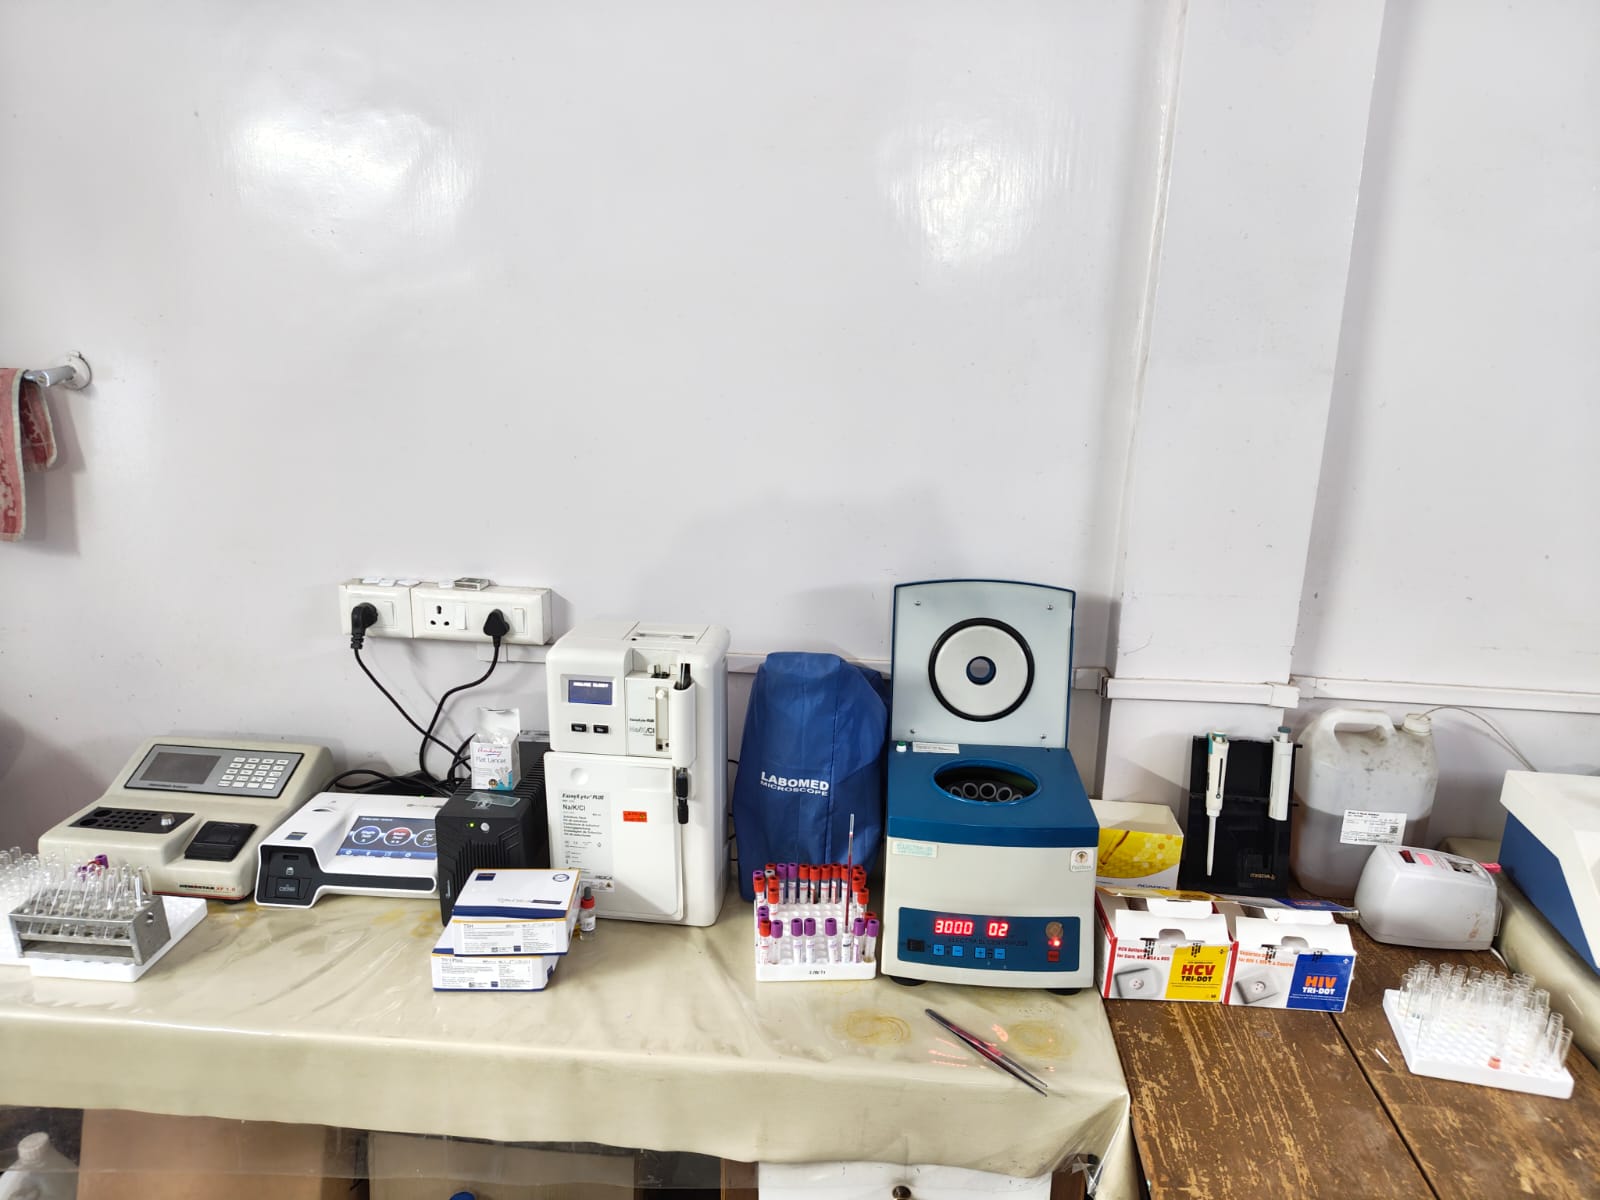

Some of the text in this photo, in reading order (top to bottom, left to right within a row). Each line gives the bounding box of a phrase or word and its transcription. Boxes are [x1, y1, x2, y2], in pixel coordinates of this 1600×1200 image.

[760, 780, 829, 797] MICROSCOPE
[761, 771, 829, 791] LABOMED
[934, 920, 1009, 937] 3000 02
[1181, 964, 1216, 976] HCV
[1305, 975, 1337, 988] HIV
[1302, 986, 1336, 995] TRI-DOT
